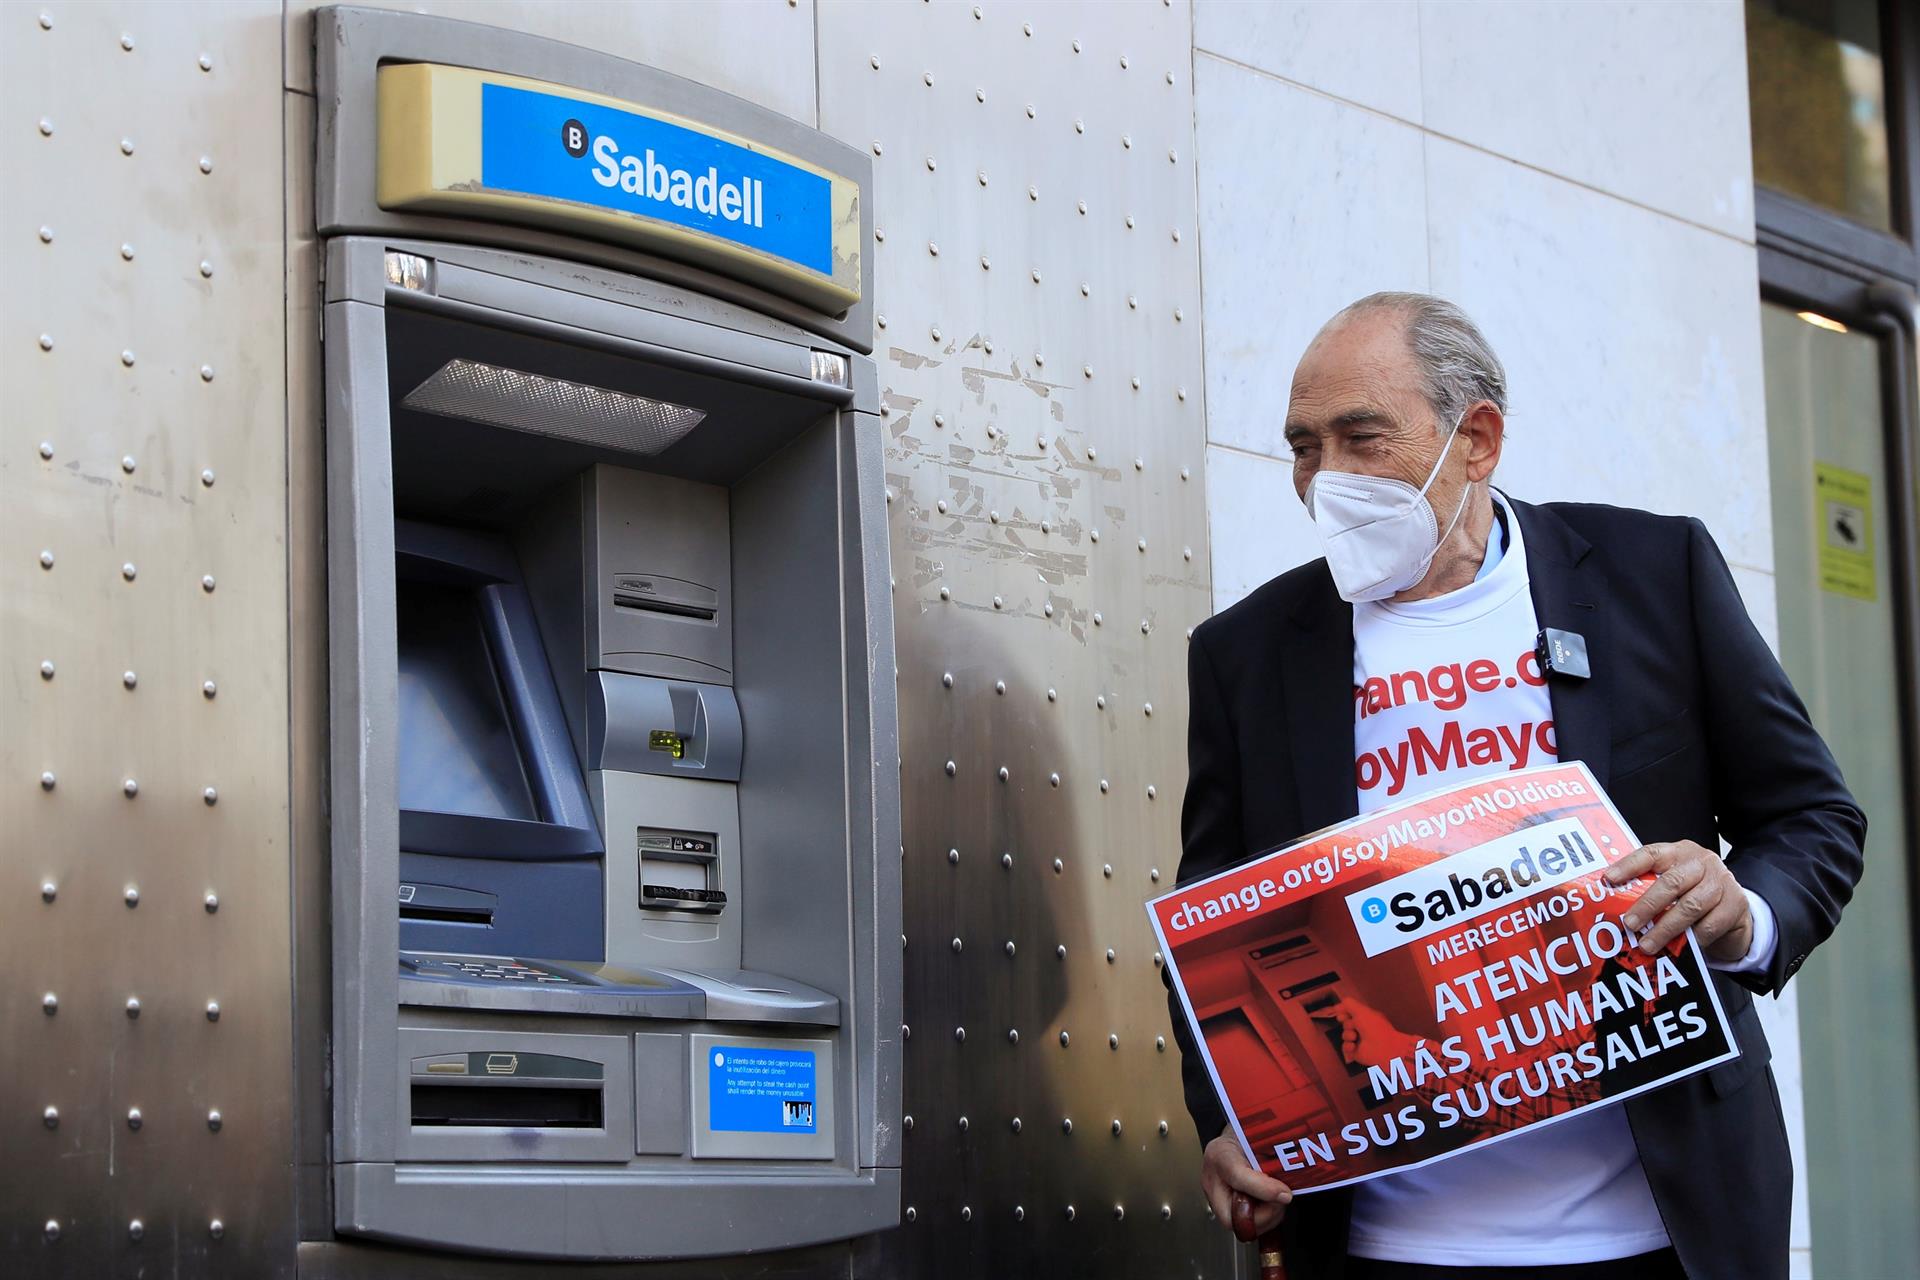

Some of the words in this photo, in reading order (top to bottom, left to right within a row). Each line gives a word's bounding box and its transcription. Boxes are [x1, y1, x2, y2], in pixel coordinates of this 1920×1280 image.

[569, 126, 582, 150] B
[592, 135, 763, 228] Sabadell
[1170, 779, 1587, 931] change.org/soyMayorNOidiota
[1390, 831, 1595, 932] Sabadell
[1426, 888, 1584, 966] MERECEMOS
[1274, 1133, 1336, 1172] EN
[1341, 1105, 1426, 1156] SUS
[1437, 1002, 1708, 1128] SUCURSALES
[1367, 1035, 1472, 1100] MÁS
[1476, 955, 1689, 1061] HUMANA
